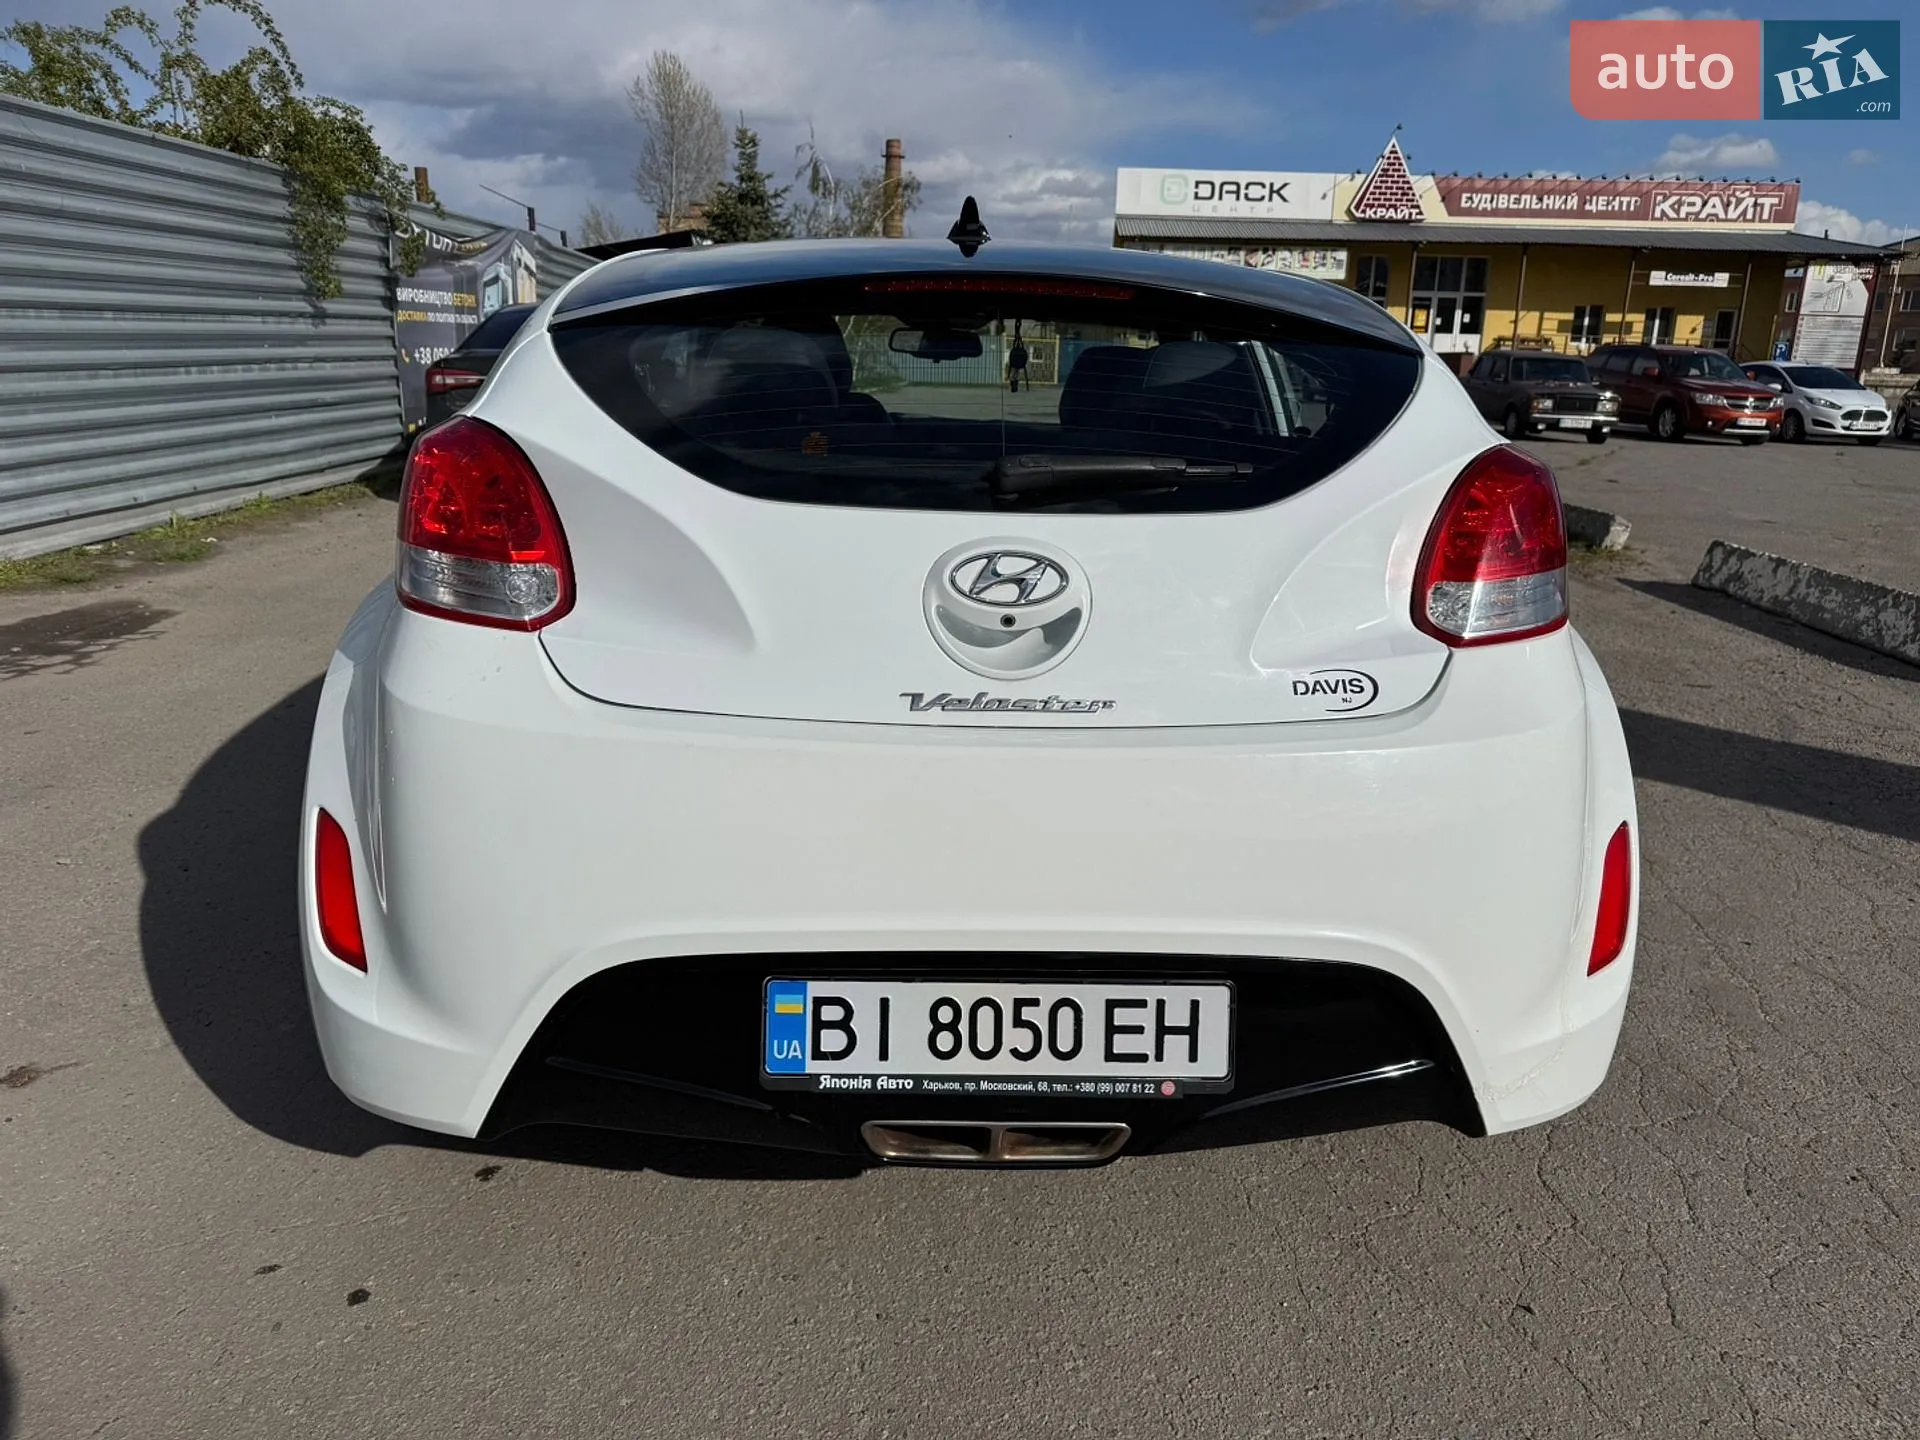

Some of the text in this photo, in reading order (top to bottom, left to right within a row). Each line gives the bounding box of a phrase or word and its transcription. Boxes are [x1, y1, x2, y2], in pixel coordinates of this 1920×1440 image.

[1193, 180, 1291, 203] DACK
[1192, 204, 1274, 214] ЦЕНТР
[1461, 192, 1641, 213] БУДІВЕЛЬНИЙ ЦЕНТР
[1654, 190, 1779, 220] КРАЙТ
[1365, 206, 1420, 221] КРАЙТ
[1292, 678, 1365, 696] DAVIS
[899, 692, 1117, 714] Veloster
[927, 996, 1084, 1062] 8050
[1103, 997, 1200, 1064] EH
[773, 1040, 803, 1060] UA
[819, 1074, 872, 1090] Японія
[876, 1075, 914, 1090] Авто
[922, 1079, 963, 1092] Харьков,
[964, 1082, 978, 1092] пр.
[980, 1079, 1036, 1093] Московский,
[1075, 1081, 1095, 1093] +380
[1115, 1081, 1130, 1094] 007
[1132, 1082, 1142, 1094] 81
[1144, 1082, 1155, 1094] 22
